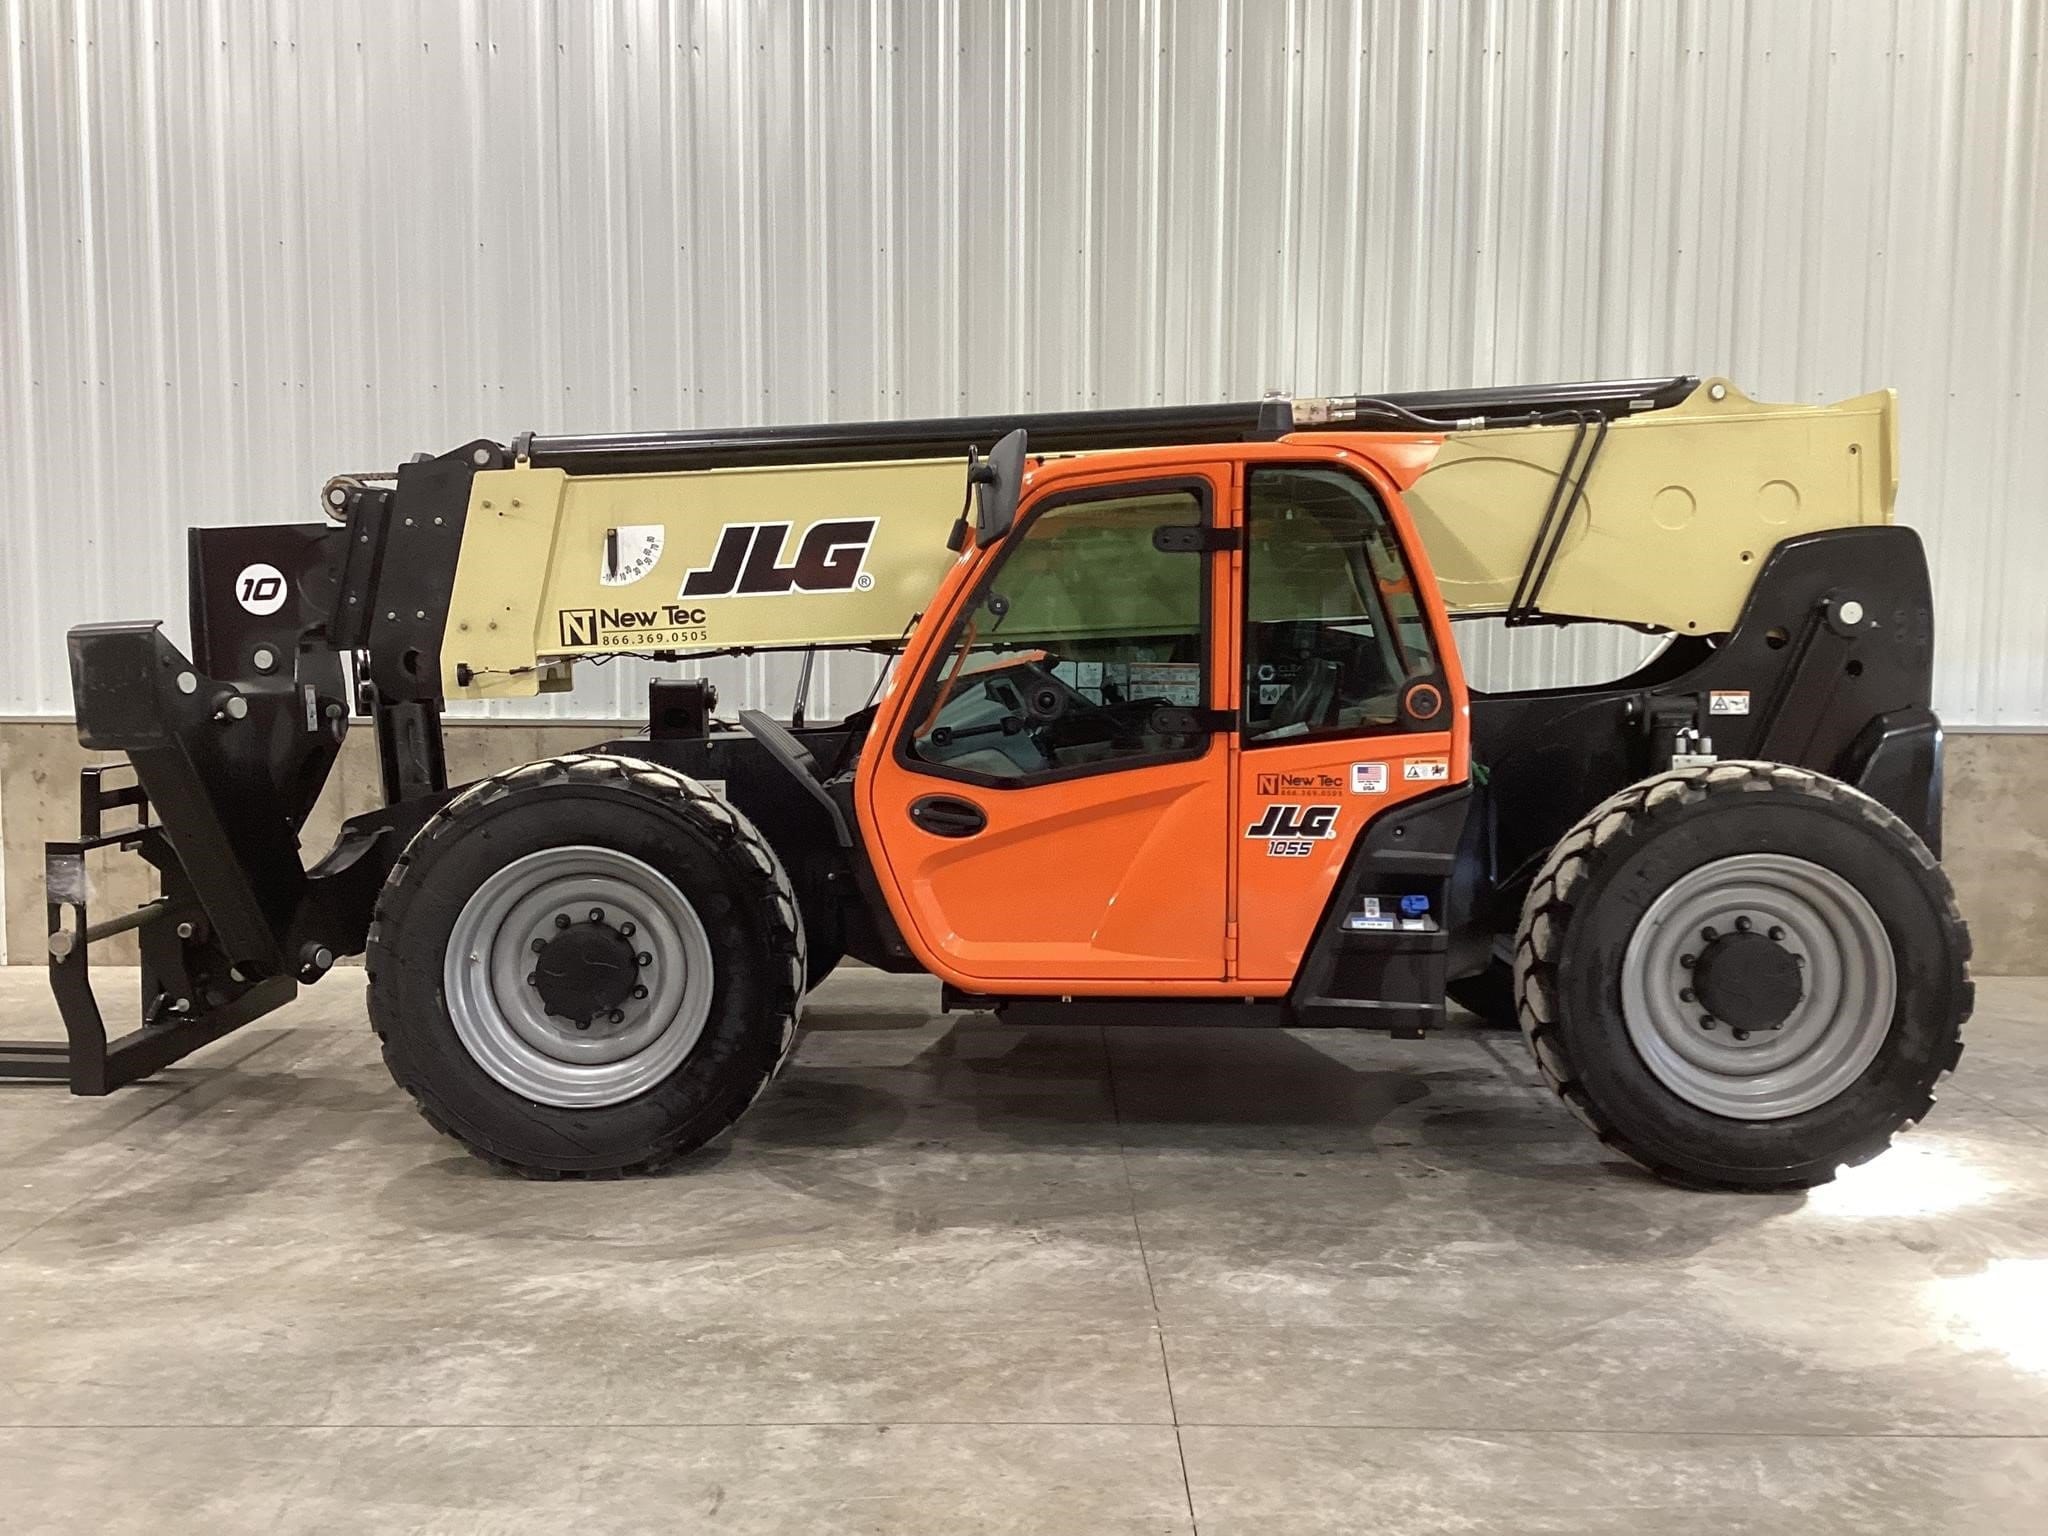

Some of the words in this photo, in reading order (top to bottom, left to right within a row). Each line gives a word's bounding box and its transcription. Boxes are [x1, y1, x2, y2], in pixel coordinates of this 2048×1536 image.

[682, 520, 876, 597] JLG
[242, 577, 282, 602] 10
[600, 608, 658, 629] New
[661, 605, 707, 625] Tec
[602, 631, 708, 646] 866.369.0505
[1281, 774, 1315, 786] New
[1317, 775, 1344, 787] Tec
[1246, 806, 1339, 837] JLG
[1268, 841, 1314, 856] 1055
